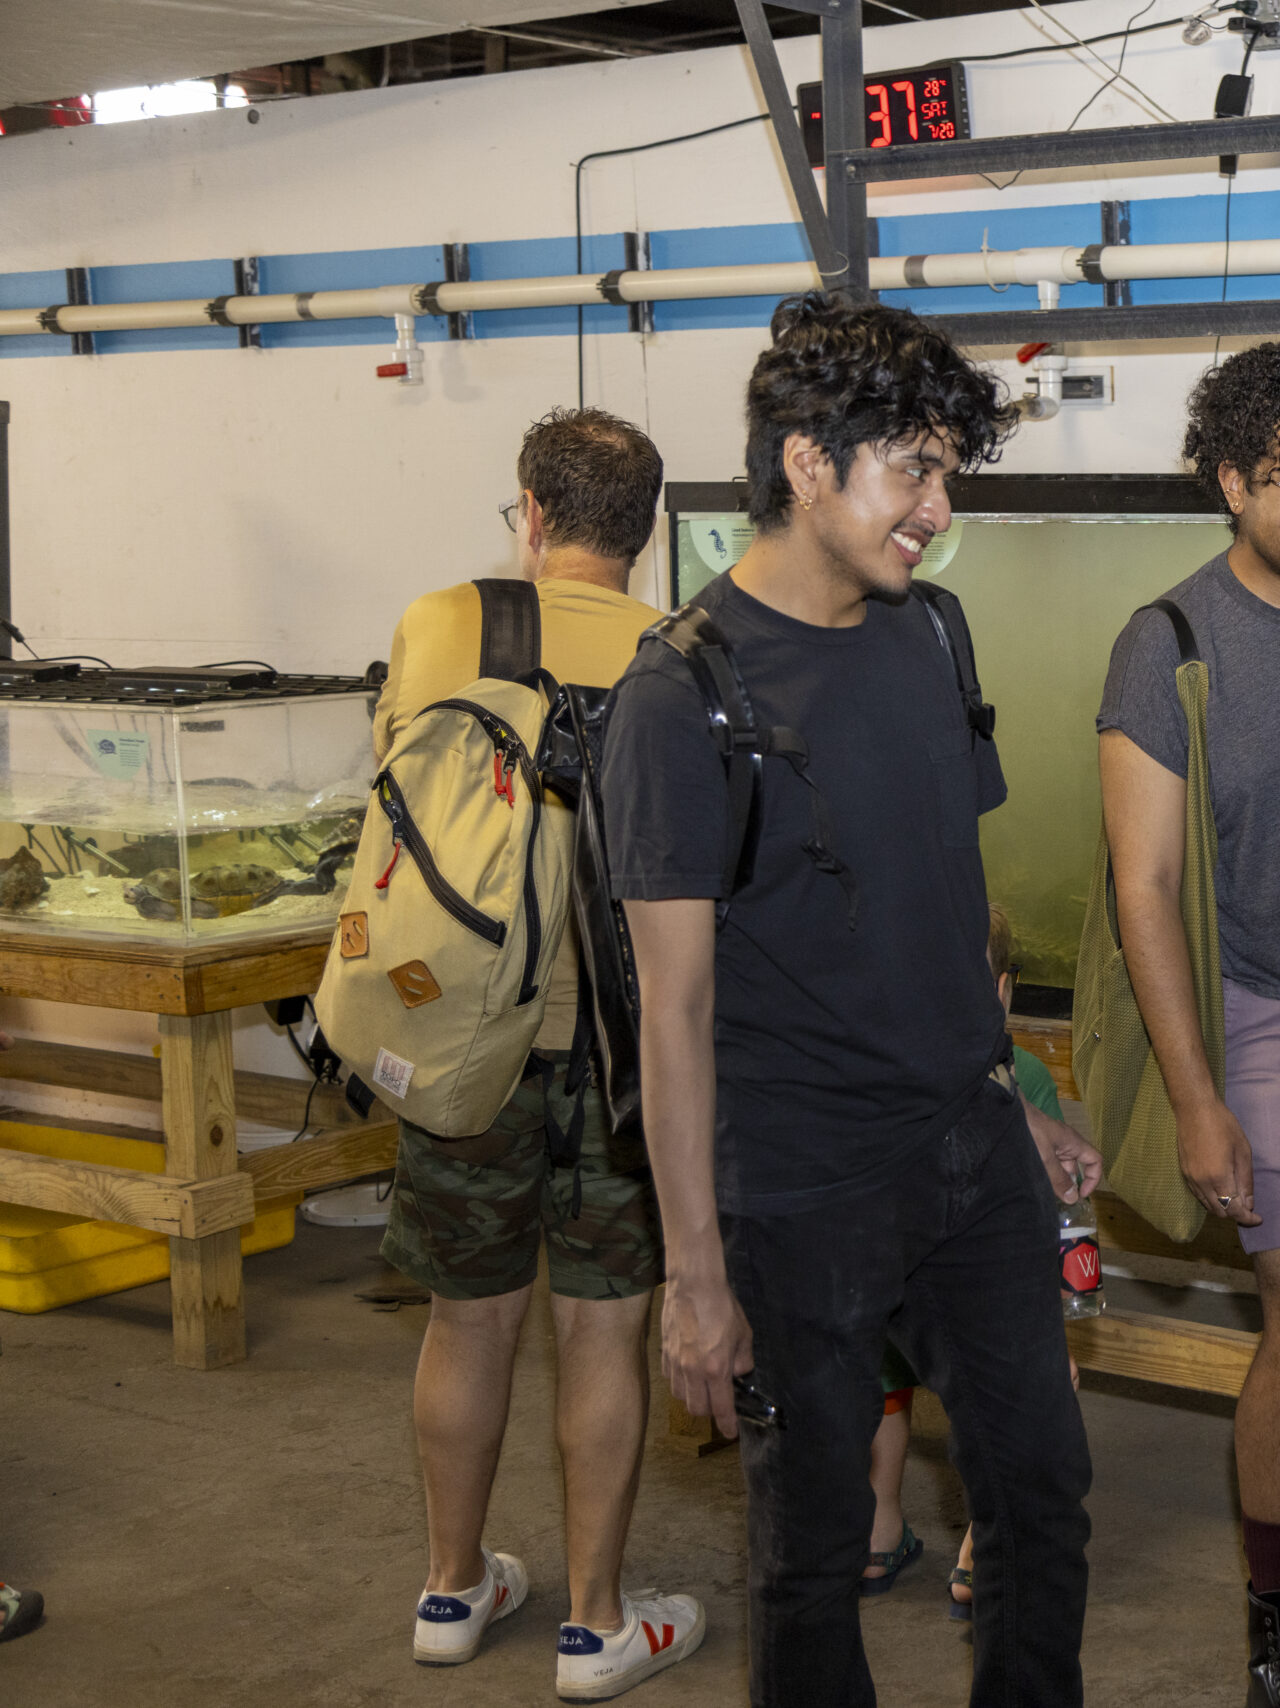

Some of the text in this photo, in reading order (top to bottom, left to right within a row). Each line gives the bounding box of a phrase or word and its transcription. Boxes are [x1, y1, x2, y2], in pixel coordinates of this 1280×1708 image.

[920, 100, 948, 119] SAT
[928, 121, 955, 139] 7/20
[424, 1603, 453, 1615] VEJA
[593, 1667, 614, 1678] VEJA
